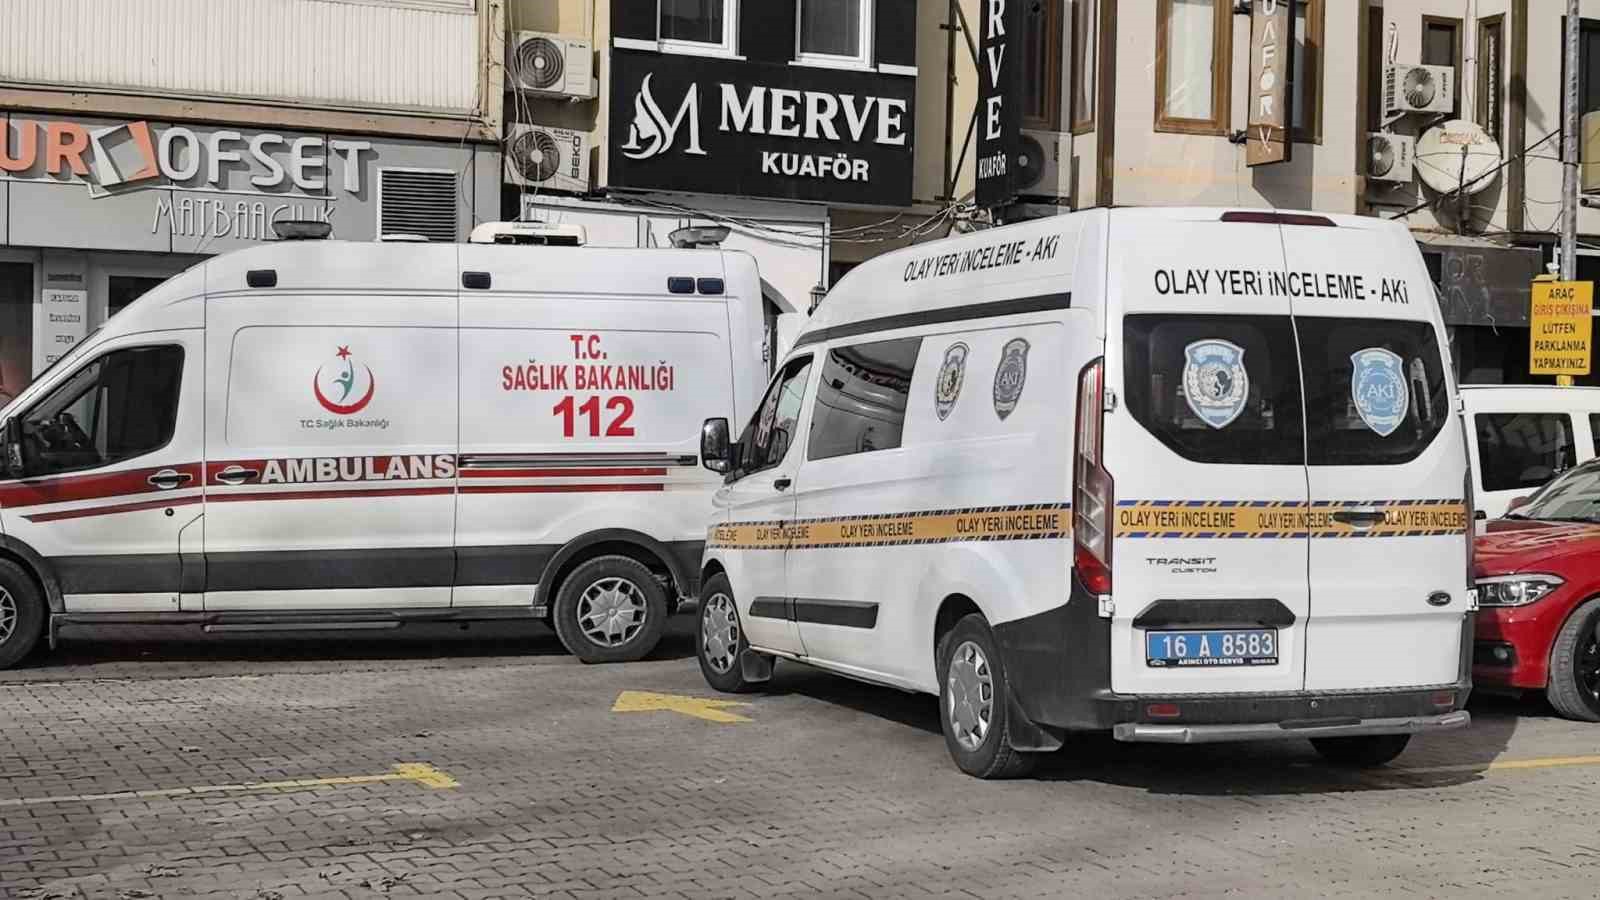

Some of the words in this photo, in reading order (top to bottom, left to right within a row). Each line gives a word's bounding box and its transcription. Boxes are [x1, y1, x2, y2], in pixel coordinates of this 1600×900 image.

[719, 83, 907, 145] MERVE
[158, 127, 371, 192] OFSET
[762, 151, 870, 181] KUAFÖR
[978, 152, 1006, 179] KUAFÖR
[904, 256, 933, 282] OLAY
[1154, 269, 1209, 295] OLAY
[570, 334, 607, 360] T.C.
[502, 359, 568, 391] SAĞLIK
[575, 361, 674, 391] BAKANLIĞI
[553, 395, 635, 438] 112
[260, 454, 456, 484] AMBULANS
[840, 524, 859, 539] OLAY
[956, 516, 982, 534] OLAY
[1120, 510, 1150, 527] OLAY
[1258, 512, 1278, 529] OLAY
[1146, 557, 1217, 565] TRANSIT
[1163, 635, 1187, 658] 16
[1199, 634, 1212, 657] A
[1222, 633, 1274, 656] 8583
